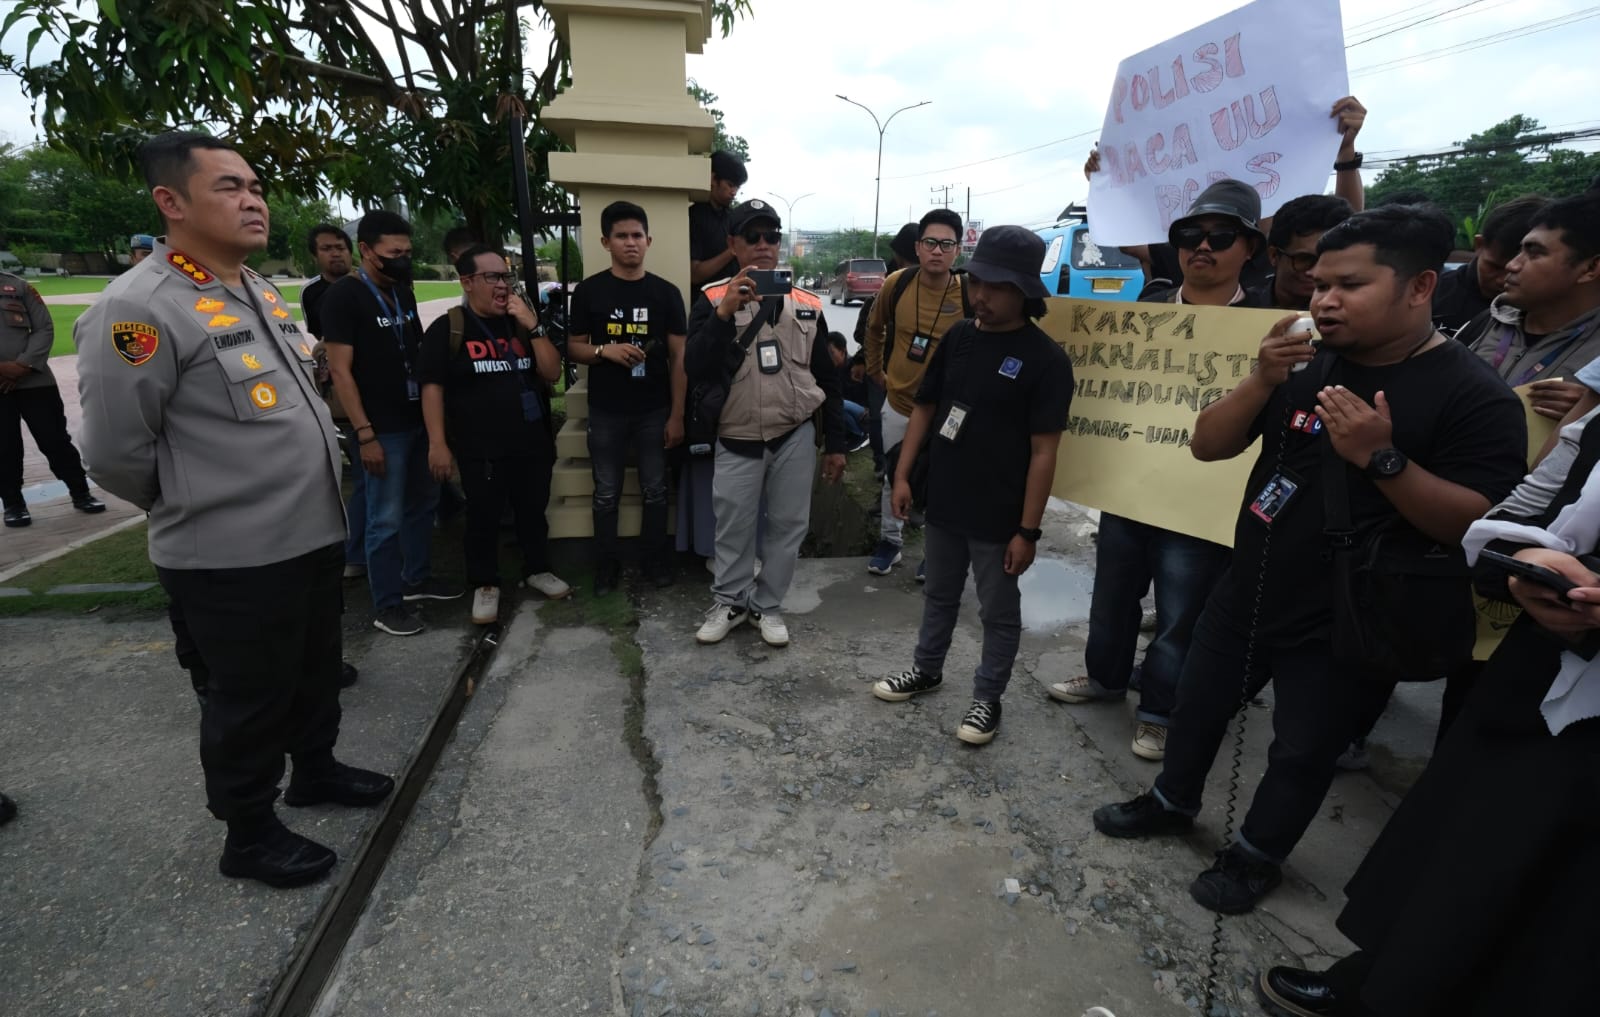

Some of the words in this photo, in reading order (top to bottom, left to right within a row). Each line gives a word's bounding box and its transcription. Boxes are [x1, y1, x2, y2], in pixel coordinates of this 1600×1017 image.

[1108, 32, 1245, 124] POLISI
[1100, 122, 1199, 188] BACA
[1209, 84, 1281, 151] UU
[1071, 304, 1197, 342] KARYA
[1056, 341, 1259, 386] URNALIST
[1073, 379, 1233, 411] ILINDUNG
